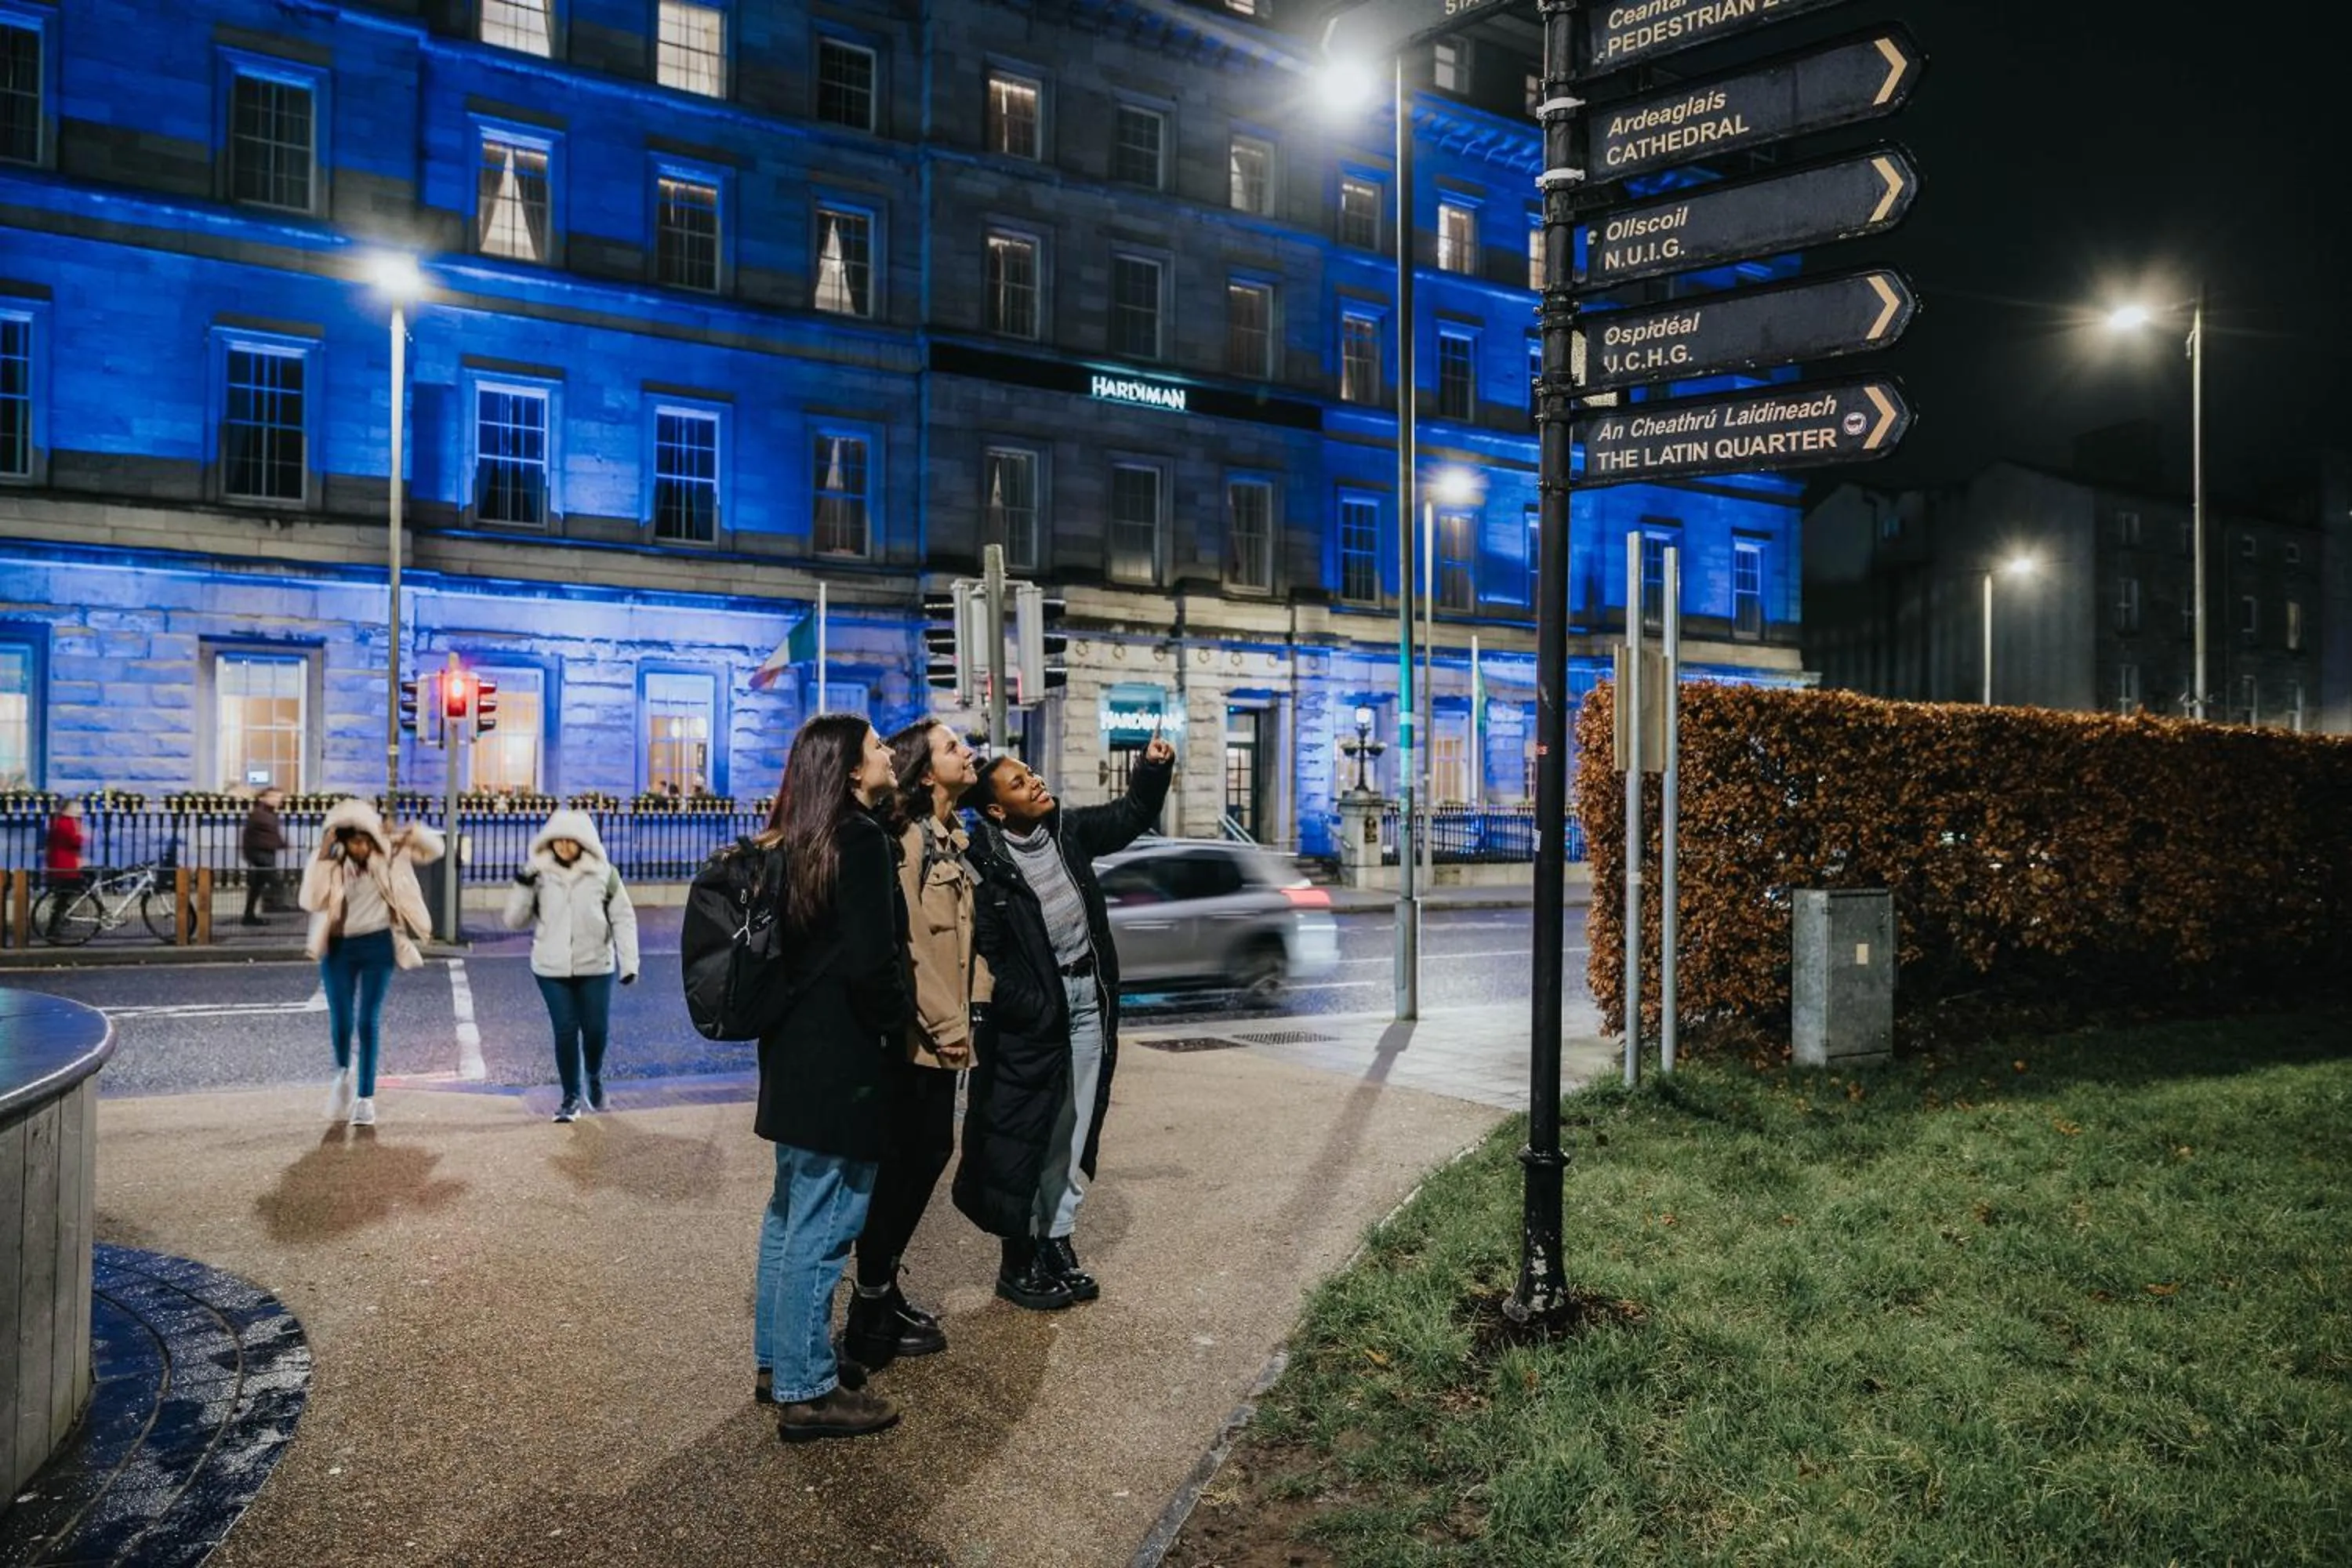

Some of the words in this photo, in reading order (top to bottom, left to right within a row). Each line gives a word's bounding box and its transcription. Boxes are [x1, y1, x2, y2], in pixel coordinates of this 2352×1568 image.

[1607, 0, 1755, 57] PEDESTRIAN
[1607, 90, 1727, 138] Ardeaglais
[1606, 114, 1750, 165] CATHEDRAL
[1606, 206, 1688, 241] Ollscoil
[1605, 238, 1685, 270] N.U.I.G.
[1604, 311, 1701, 347] Ospidéal
[1603, 344, 1693, 373] U.C.H.G.
[1091, 376, 1185, 410] HARDIMAN
[1597, 423, 1624, 441] An
[1631, 408, 1717, 437] Cheathrú
[1724, 394, 1837, 427] Laidineach
[1596, 449, 1639, 471] THE
[1644, 441, 1708, 466] LATIN
[1715, 428, 1838, 459] QUARTER
